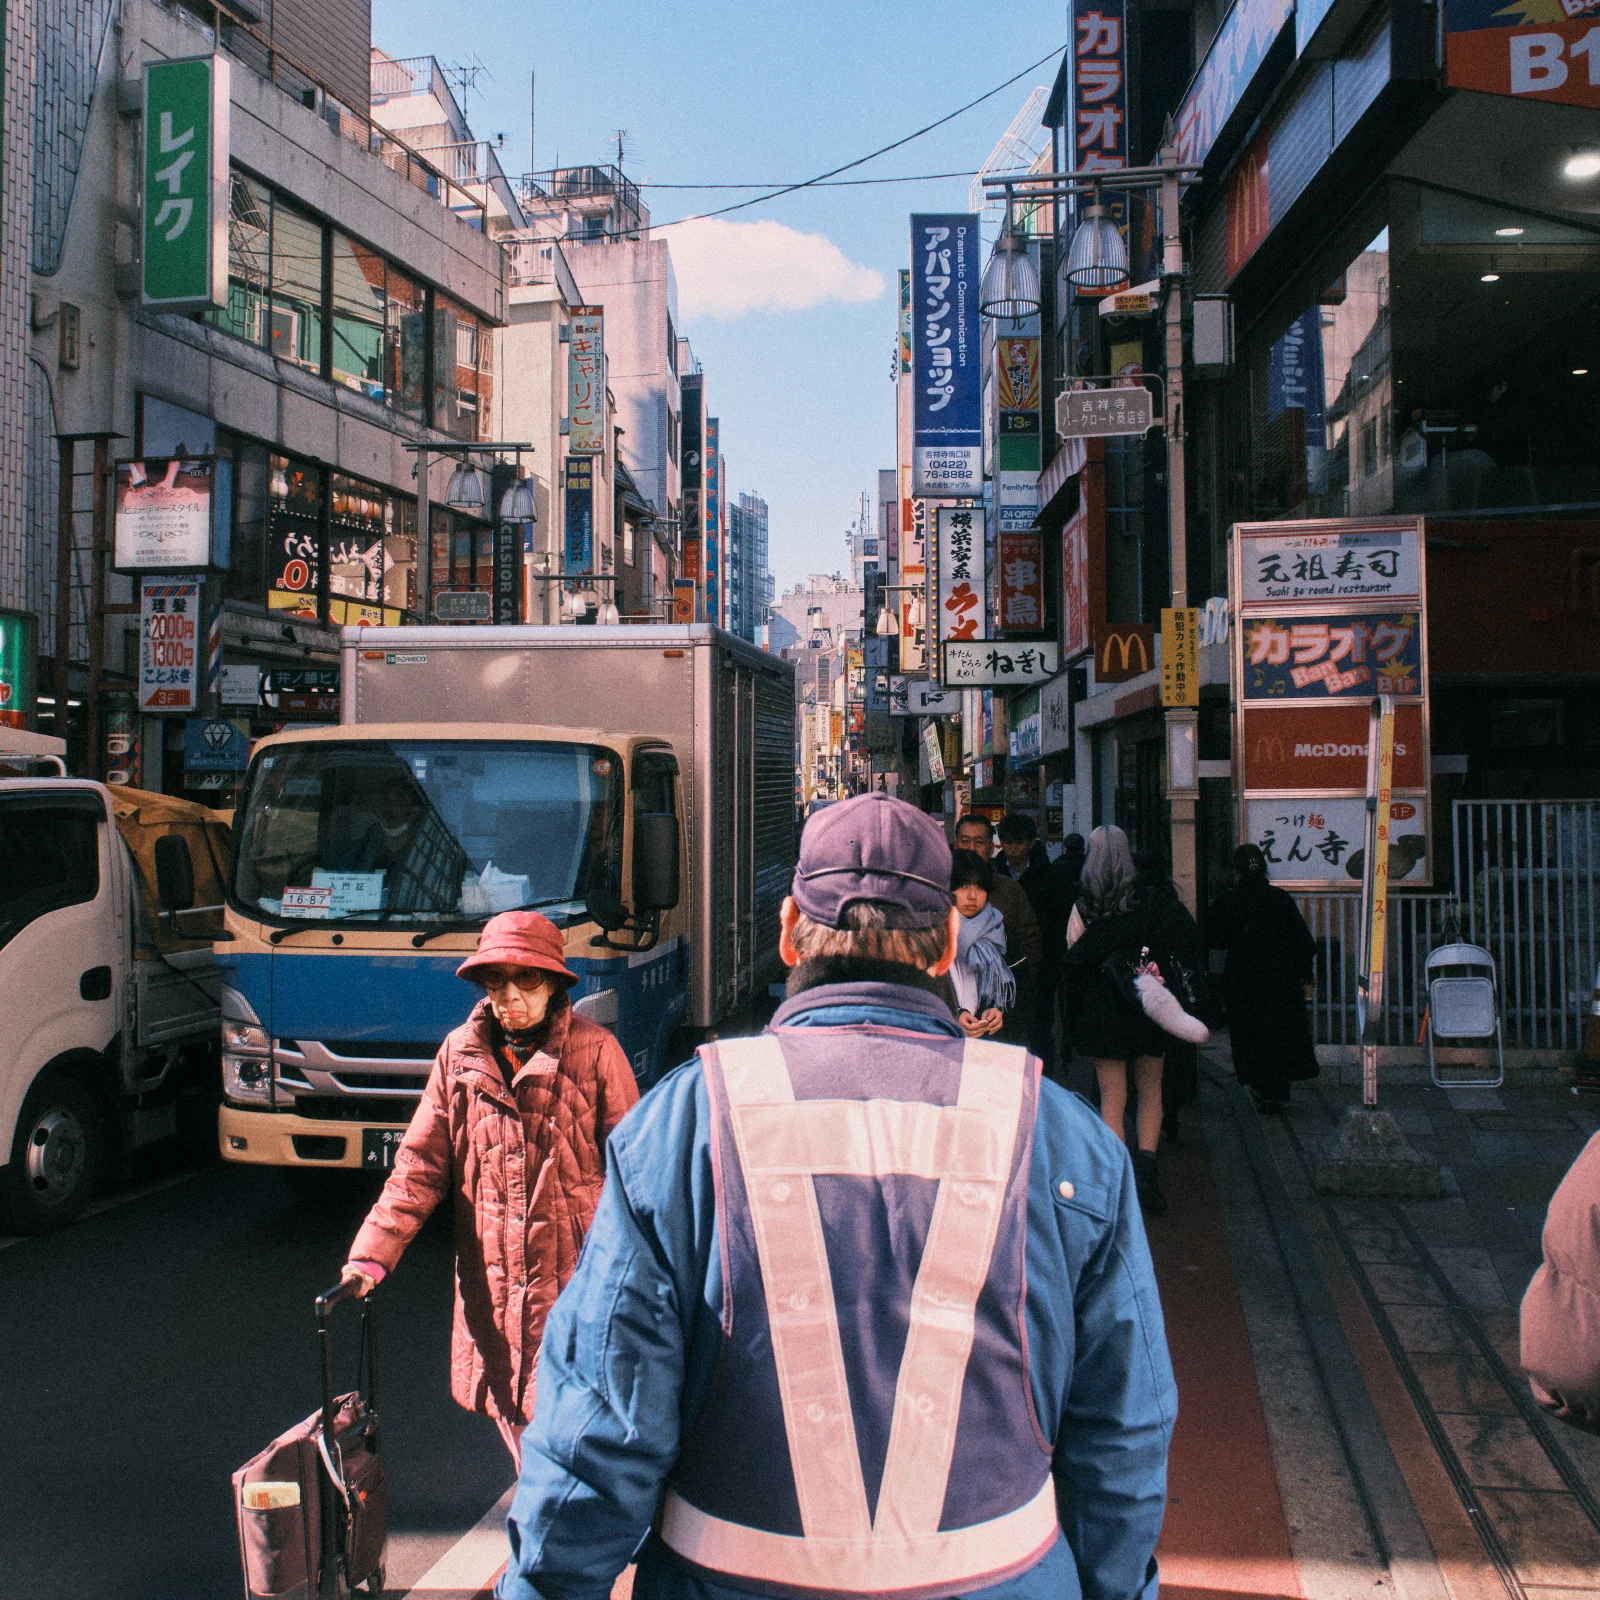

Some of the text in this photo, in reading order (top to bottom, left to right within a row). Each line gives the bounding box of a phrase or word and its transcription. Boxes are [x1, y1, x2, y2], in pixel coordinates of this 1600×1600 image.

[155, 111, 195, 241] レイク
[957, 226, 967, 367] Dramatic Communication
[578, 307, 593, 315] 4F
[924, 226, 955, 412] アパマンショップ
[573, 338, 594, 425] きゃりこ
[1081, 398, 1126, 412] 吉祥寺
[1013, 415, 1031, 428] 3F
[583, 440, 601, 449] 入口
[925, 450, 971, 458] 吉祥寺南口店
[929, 460, 967, 469] (0422)
[923, 470, 973, 479] 76-8882
[1002, 510, 1038, 518] 24 OPEN
[1014, 521, 1032, 529] たば
[949, 512, 973, 580] 横浜家系
[500, 521, 513, 593] CELSIOR
[1257, 549, 1400, 583] 元祖寿司
[1003, 558, 1039, 625] 串鳥
[1265, 582, 1391, 597] Sushi go round restaurant
[152, 598, 187, 613] 理髪
[151, 614, 194, 640] 2000円
[1249, 622, 1413, 665] カラオケ
[152, 641, 194, 667] 1300円
[949, 649, 972, 657] 牛たん
[961, 659, 982, 668] とろろ
[984, 648, 1056, 677] ねぎし
[144, 668, 191, 684] ことぶき
[1290, 662, 1371, 694] Ban Ban
[1376, 675, 1417, 694] B1F
[158, 691, 175, 705] 3F
[317, 698, 340, 710] KF
[1294, 742, 1406, 757] McDon's
[1390, 806, 1411, 817] 1F
[1275, 813, 1326, 830] つけ麺
[1374, 751, 1392, 914] 小田急バス
[329, 881, 365, 891] 入門証
[367, 1151, 378, 1162] あ
